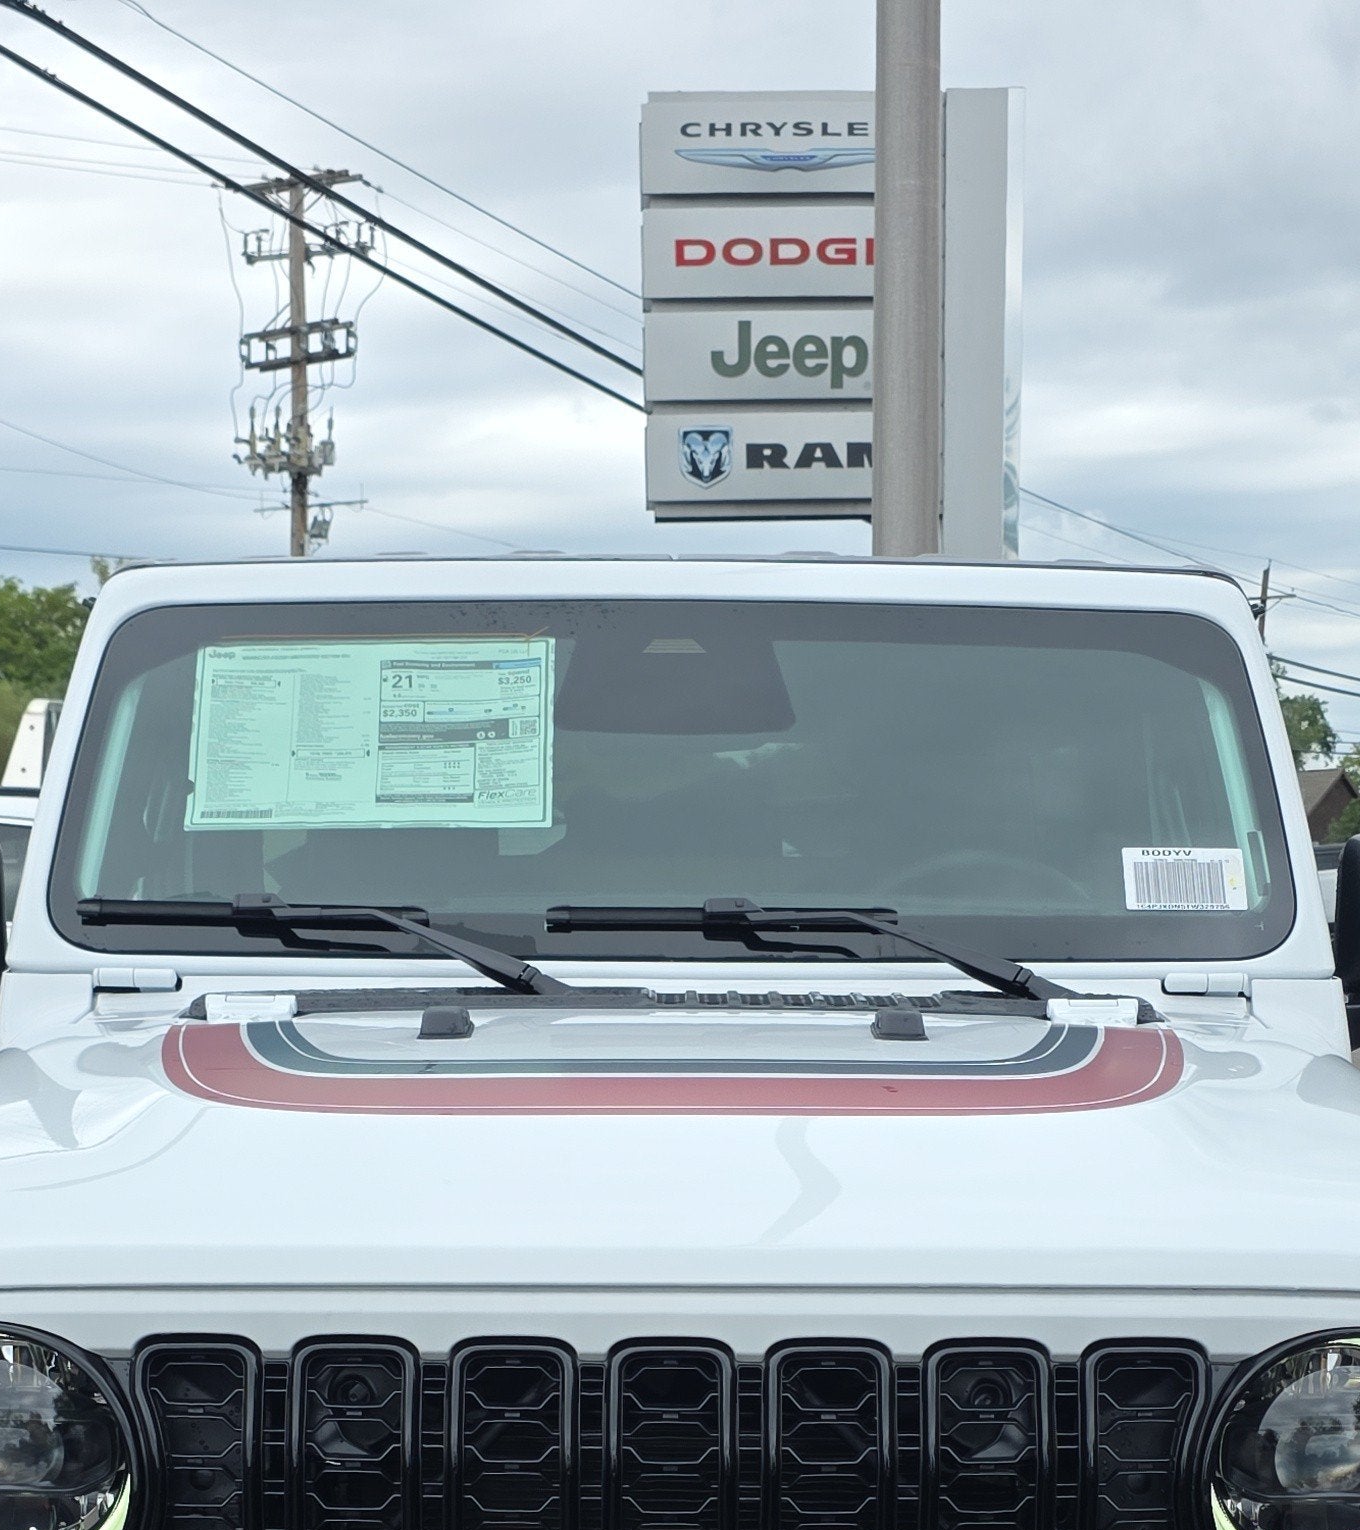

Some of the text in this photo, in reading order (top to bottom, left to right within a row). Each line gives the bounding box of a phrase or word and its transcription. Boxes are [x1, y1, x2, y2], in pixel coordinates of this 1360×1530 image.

[680, 121, 870, 138] CHRYSLE
[711, 320, 869, 390] Jeep
[391, 674, 413, 689] 21
[497, 675, 532, 685] $3,250
[382, 709, 418, 718] $2,350
